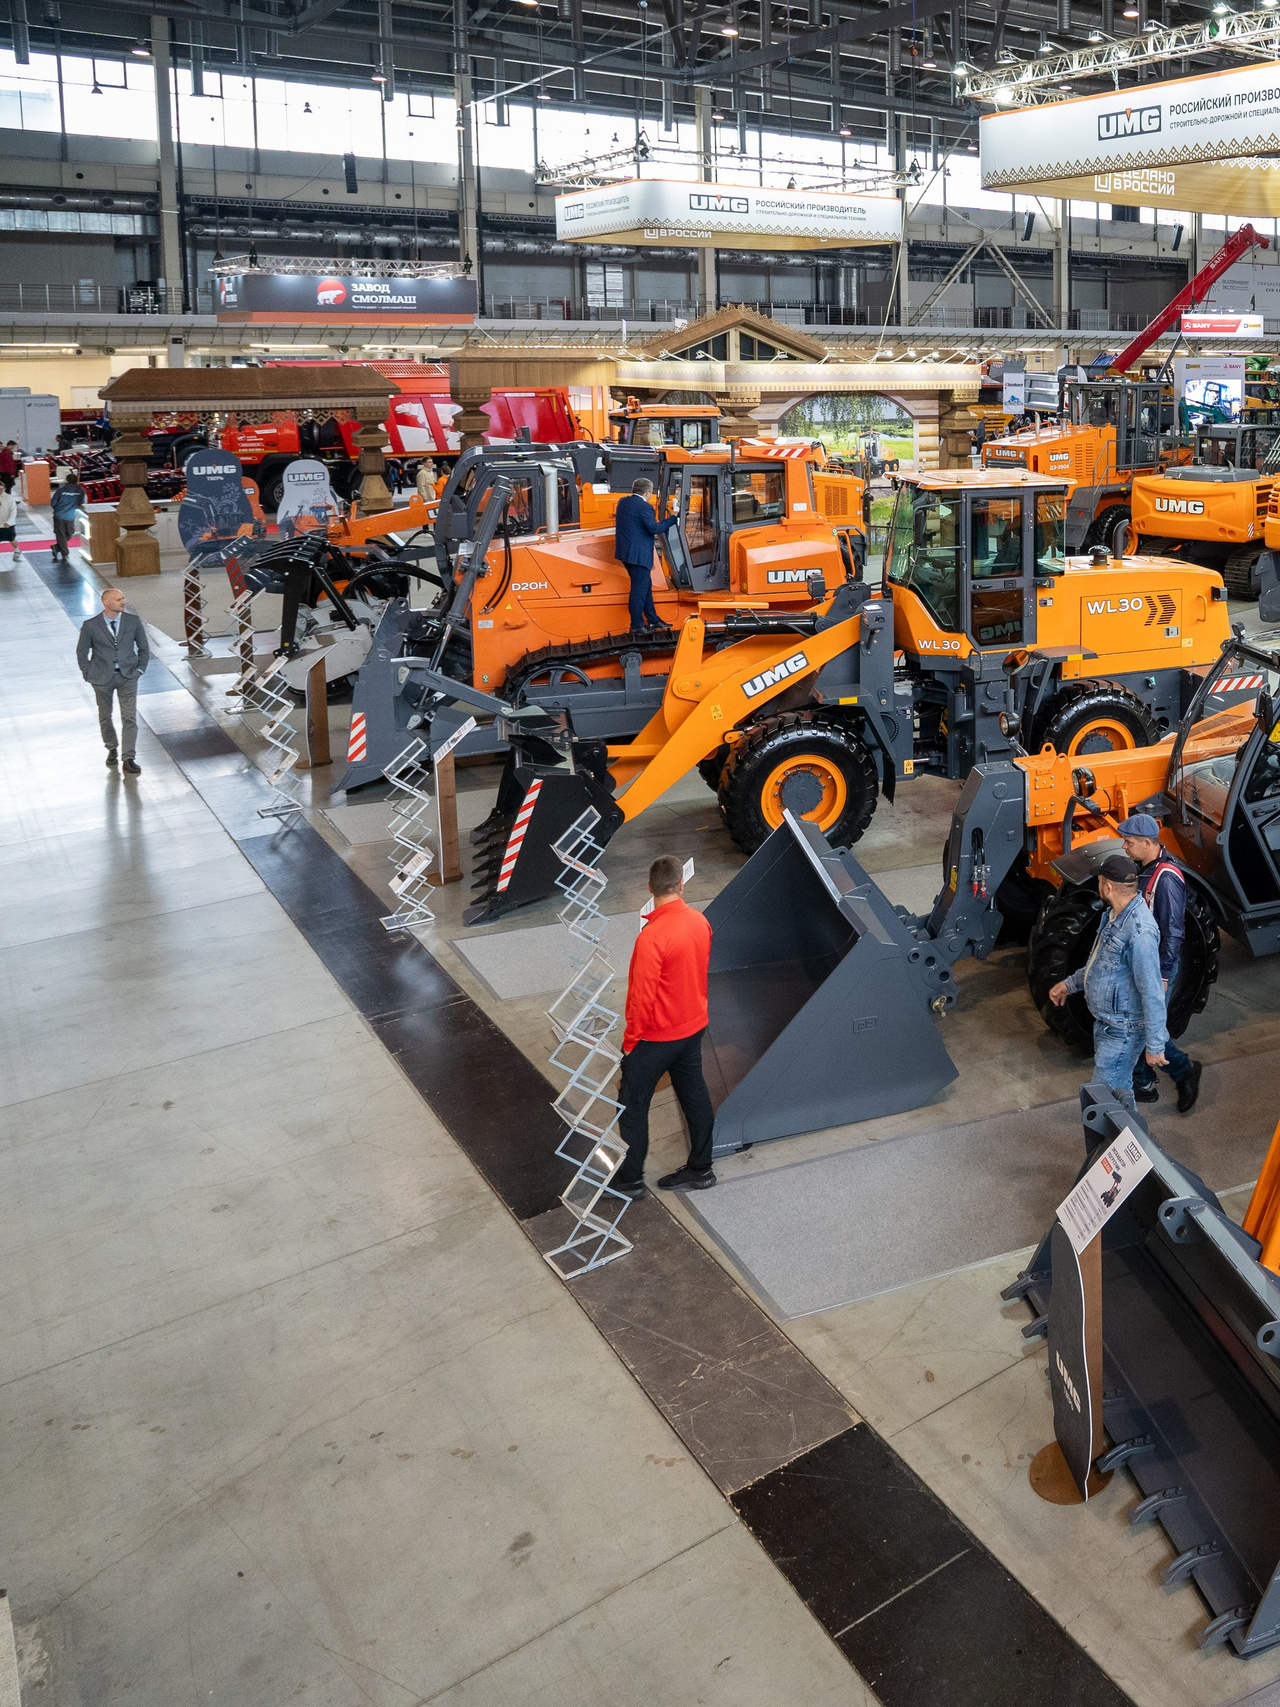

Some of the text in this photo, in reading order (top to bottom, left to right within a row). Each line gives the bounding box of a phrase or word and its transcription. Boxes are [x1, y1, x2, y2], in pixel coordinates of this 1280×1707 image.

[1169, 93, 1232, 116] РОССИЙСКИЙ
[1099, 108, 1160, 139] UMG
[1169, 110, 1243, 130] СТРОИТЕЛЬНО-ДОРОЖНОЙ
[691, 194, 749, 213] UMG
[755, 199, 867, 215] РОССИЙСКИЙ ПРОИЗВОДИТЕЛЬ
[565, 204, 584, 221] UMG
[1209, 249, 1227, 269] SANY
[351, 283, 390, 294] ЗАВОД
[351, 295, 417, 304] СМОЛМАШ
[995, 448, 1017, 458] UMG
[1049, 452, 1070, 462] UMG
[192, 464, 237, 476] UMG
[288, 473, 325, 482] UMG
[1155, 497, 1204, 514] UMG
[511, 581, 548, 591] D20H
[1086, 597, 1143, 615] WL30
[918, 640, 960, 650] WL30
[744, 653, 808, 697] UMG
[1127, 1141, 1142, 1162] UMG
[1056, 1350, 1081, 1413] UMG
